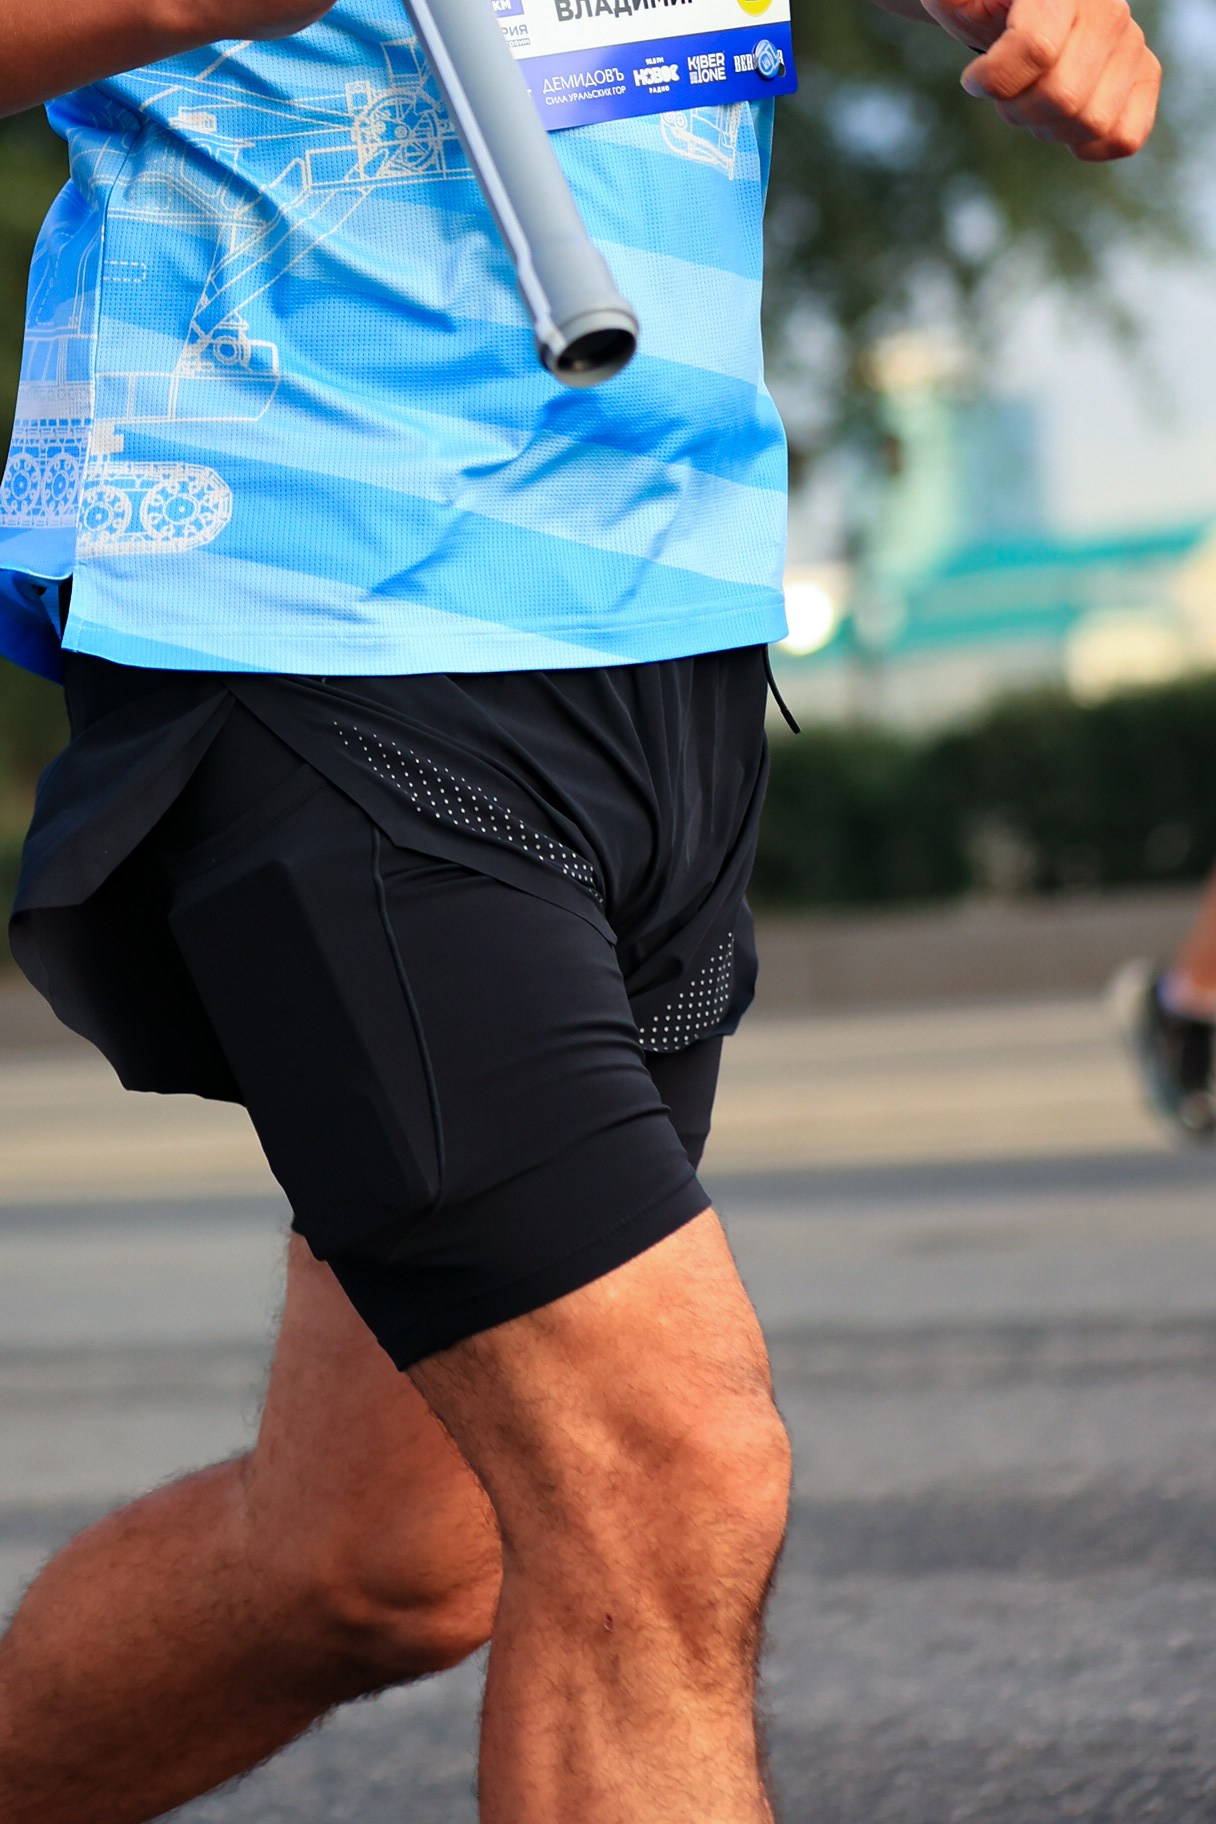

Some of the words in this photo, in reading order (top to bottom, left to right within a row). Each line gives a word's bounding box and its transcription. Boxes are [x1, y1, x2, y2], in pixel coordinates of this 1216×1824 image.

[502, 24, 529, 37] РИЯ
[542, 67, 625, 94] ДЕМИДОВЪ
[545, 94, 569, 105] СИЛА
[569, 87, 612, 102] УРАЛЬСКИХ
[612, 85, 626, 96] ГОР
[648, 85, 670, 94] РАДИО
